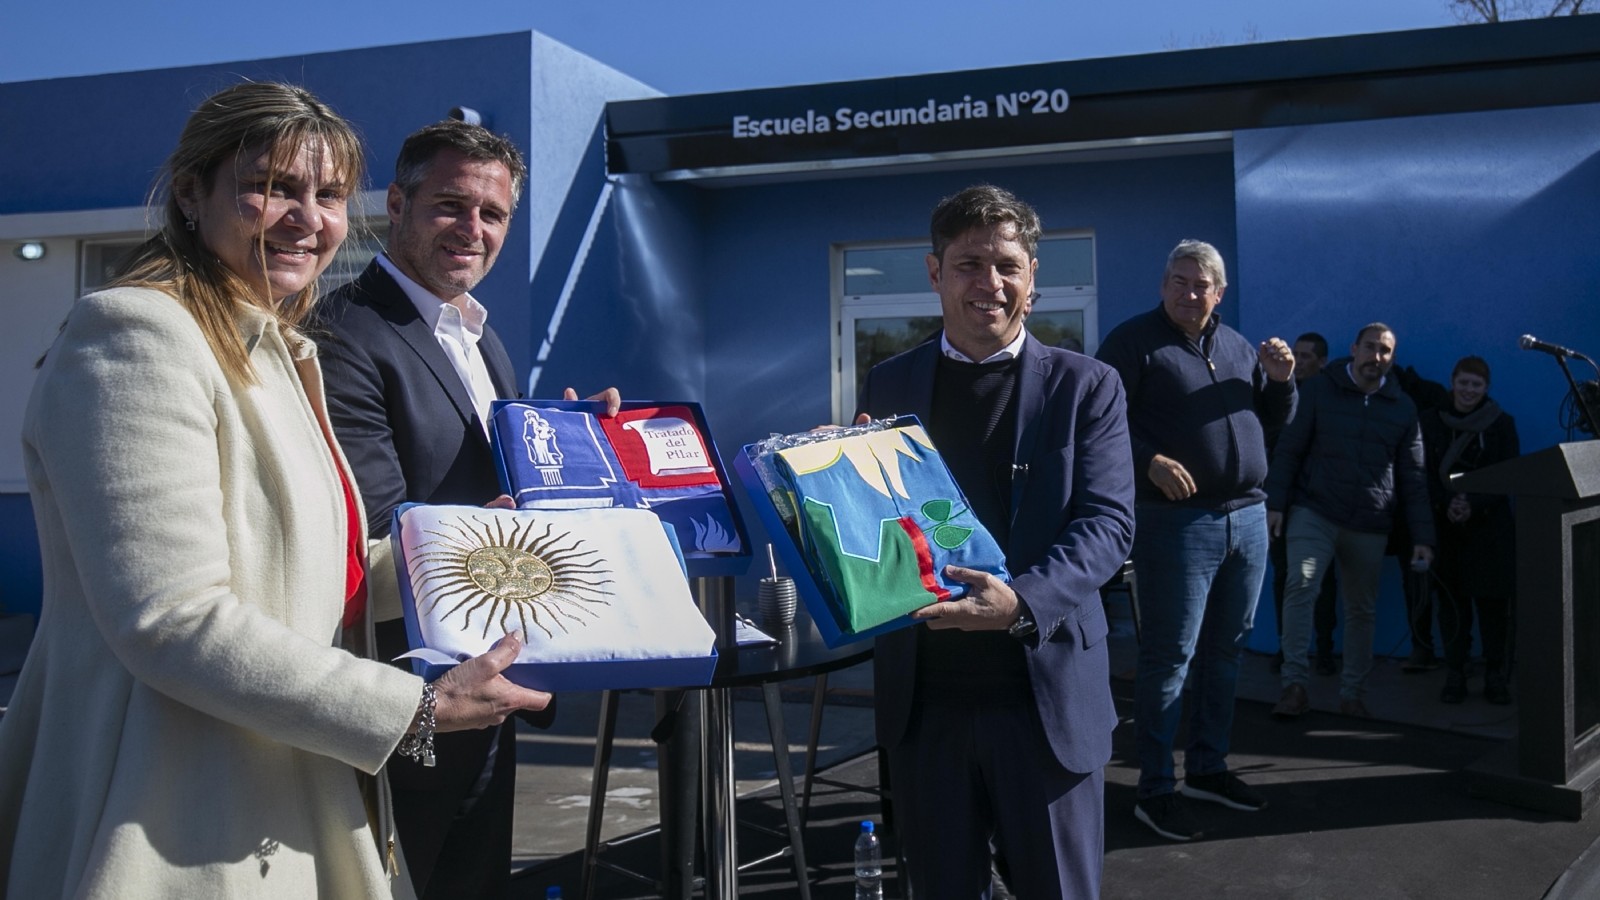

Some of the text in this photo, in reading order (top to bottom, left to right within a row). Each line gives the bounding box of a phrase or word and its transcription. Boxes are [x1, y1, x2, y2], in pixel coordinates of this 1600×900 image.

[733, 110, 830, 138] Escuela
[836, 95, 988, 130] Secundaria
[644, 427, 694, 439] Tratado
[665, 438, 687, 448] del
[666, 449, 699, 460] Pilar
